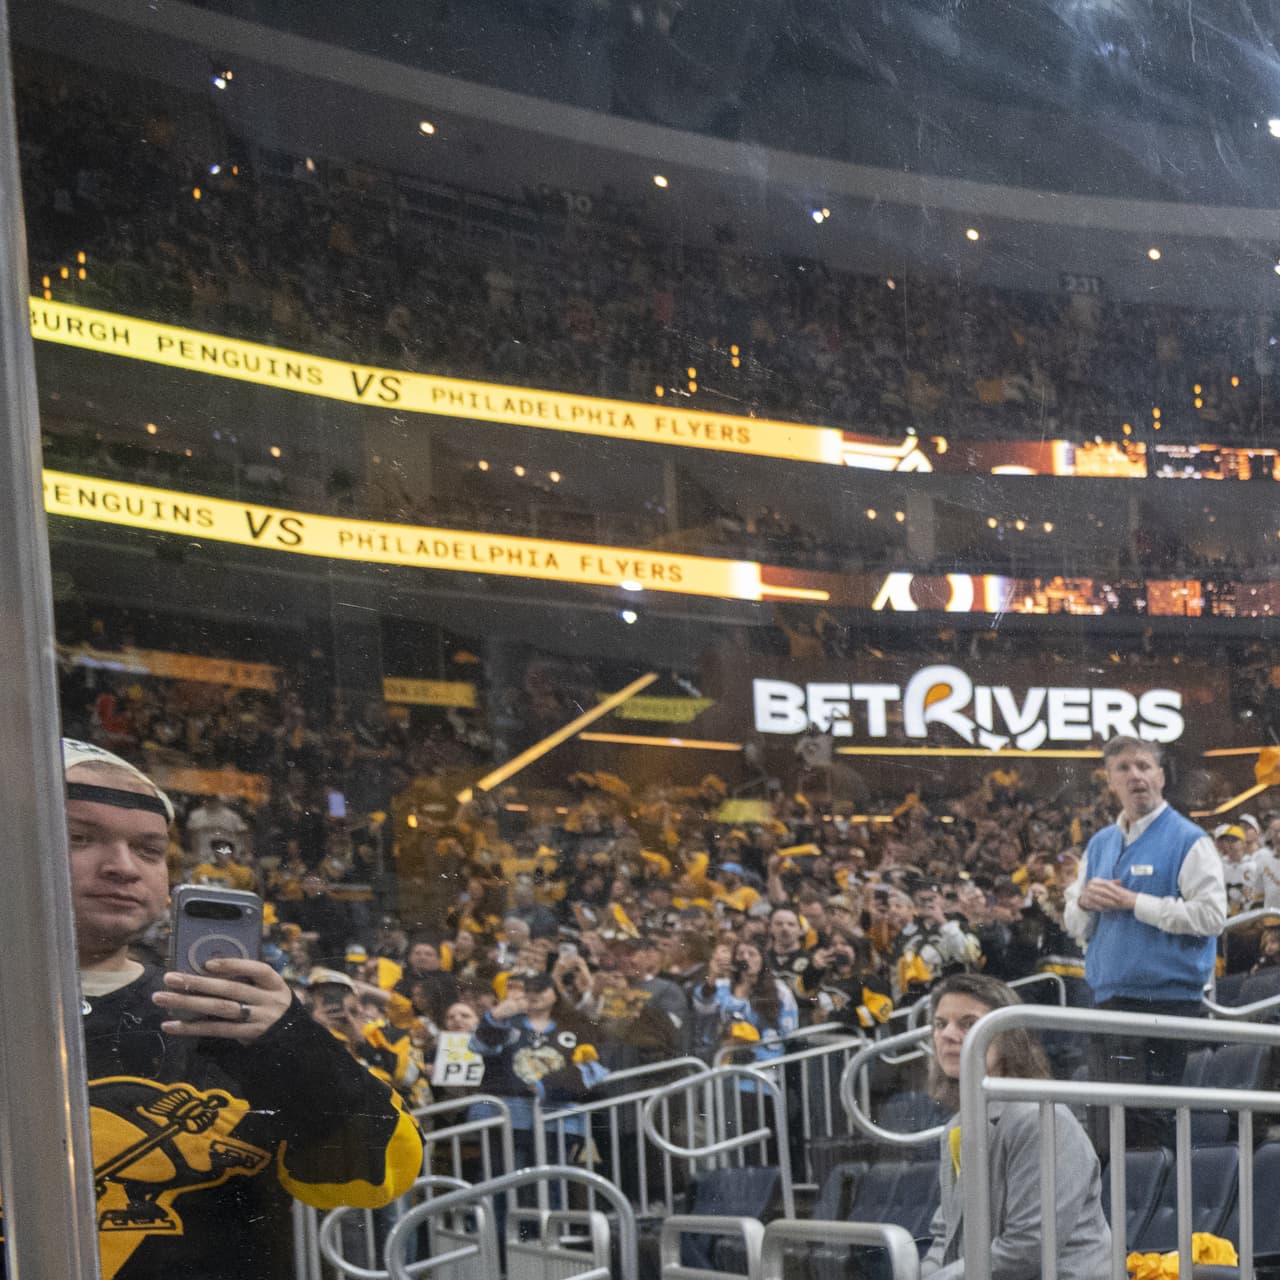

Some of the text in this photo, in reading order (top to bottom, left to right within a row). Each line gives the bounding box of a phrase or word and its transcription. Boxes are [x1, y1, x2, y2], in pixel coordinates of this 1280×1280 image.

[158, 334, 324, 387] PENGUINS
[351, 370, 403, 403] VS
[431, 387, 637, 429] PHILADELPHIA
[655, 415, 753, 445] FLYERS
[43, 484, 684, 584] ENGUINS VS PHILADELPHIA FLYERS
